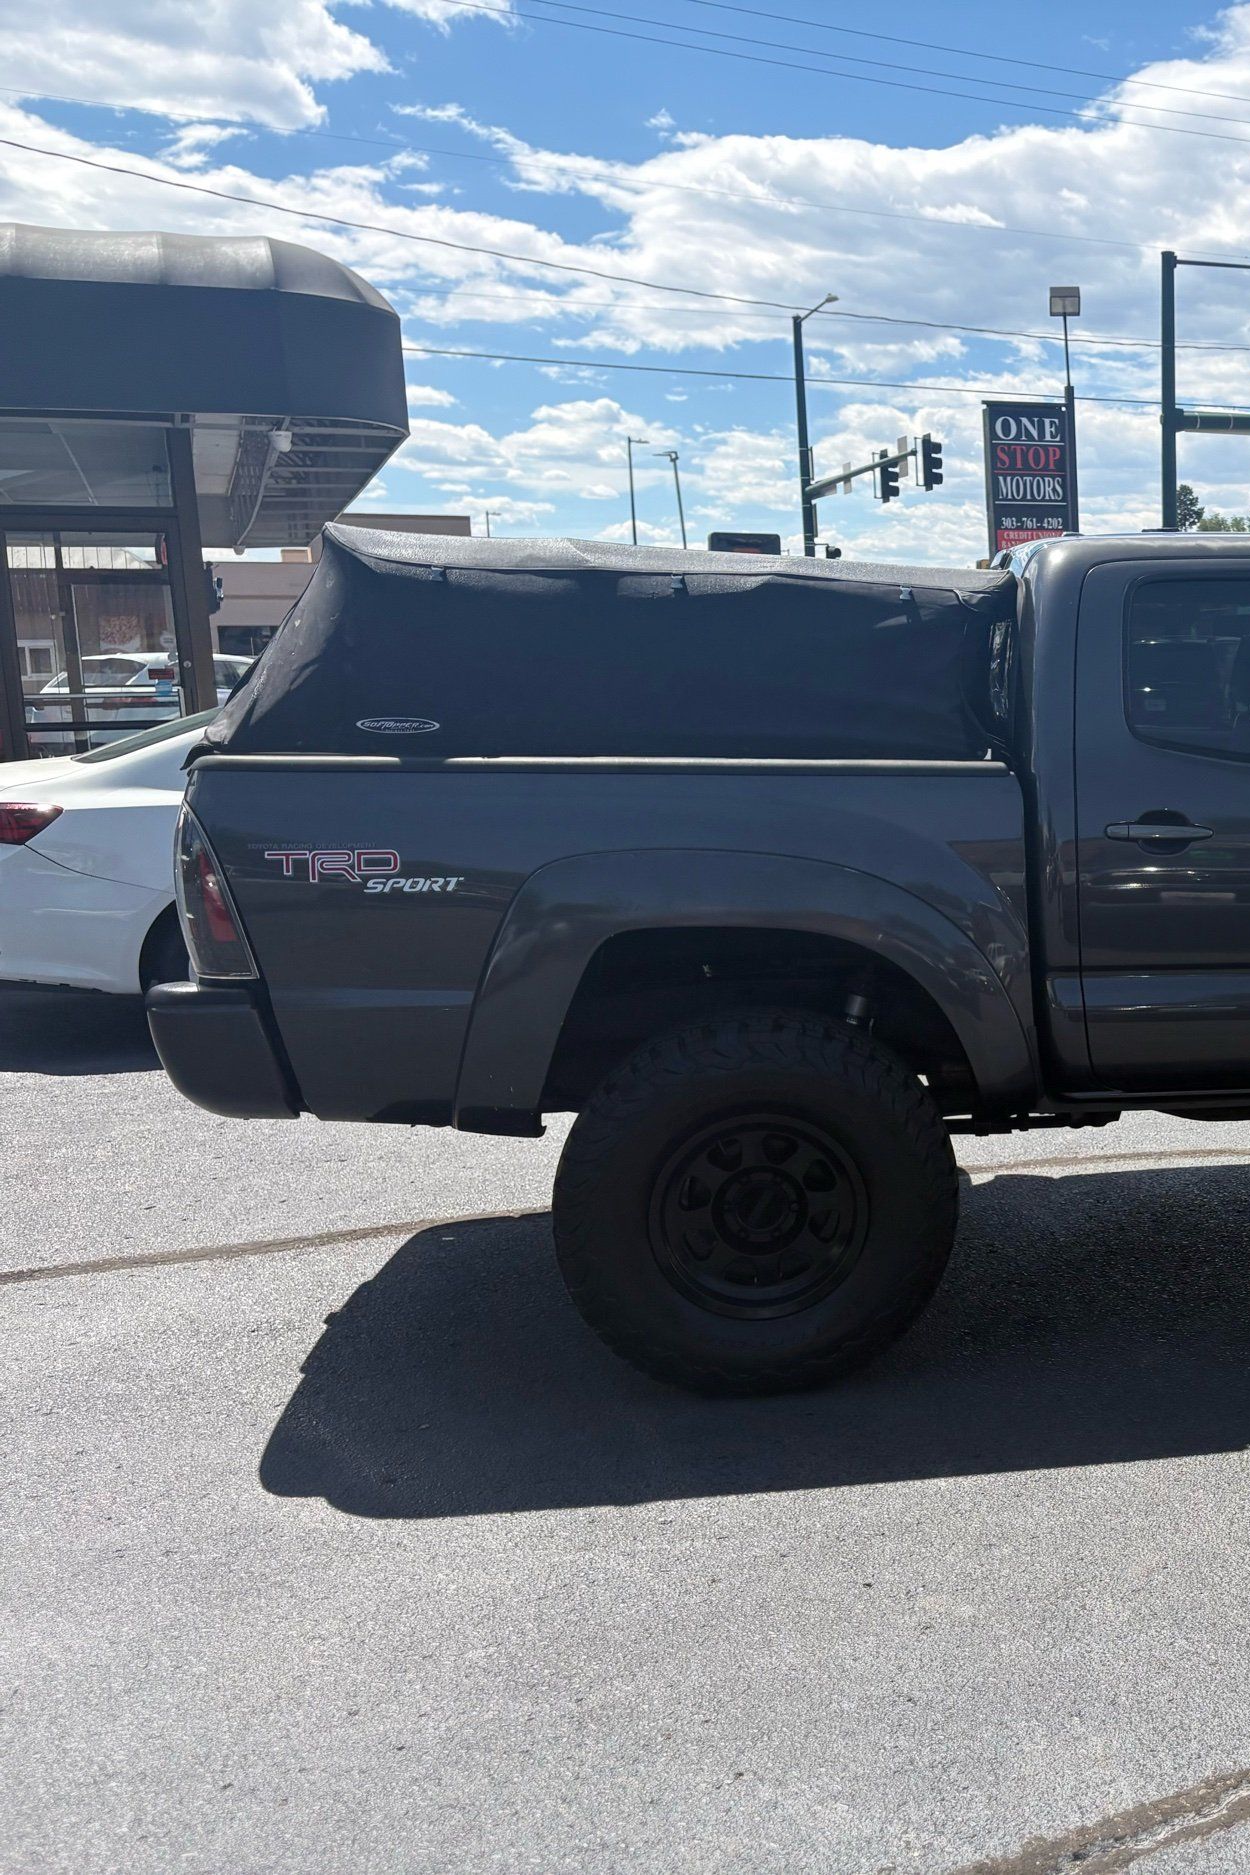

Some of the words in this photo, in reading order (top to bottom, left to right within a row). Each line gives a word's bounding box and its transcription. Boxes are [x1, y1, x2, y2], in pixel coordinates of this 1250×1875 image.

[995, 416, 1061, 441] ONE
[996, 446, 1061, 469] STOP
[998, 476, 1063, 500] MOTORS
[1001, 517, 1063, 529] 303-761-4202
[1004, 531, 1031, 540] CREDIT
[265, 850, 400, 882] TRD
[363, 877, 464, 893] SPORT
